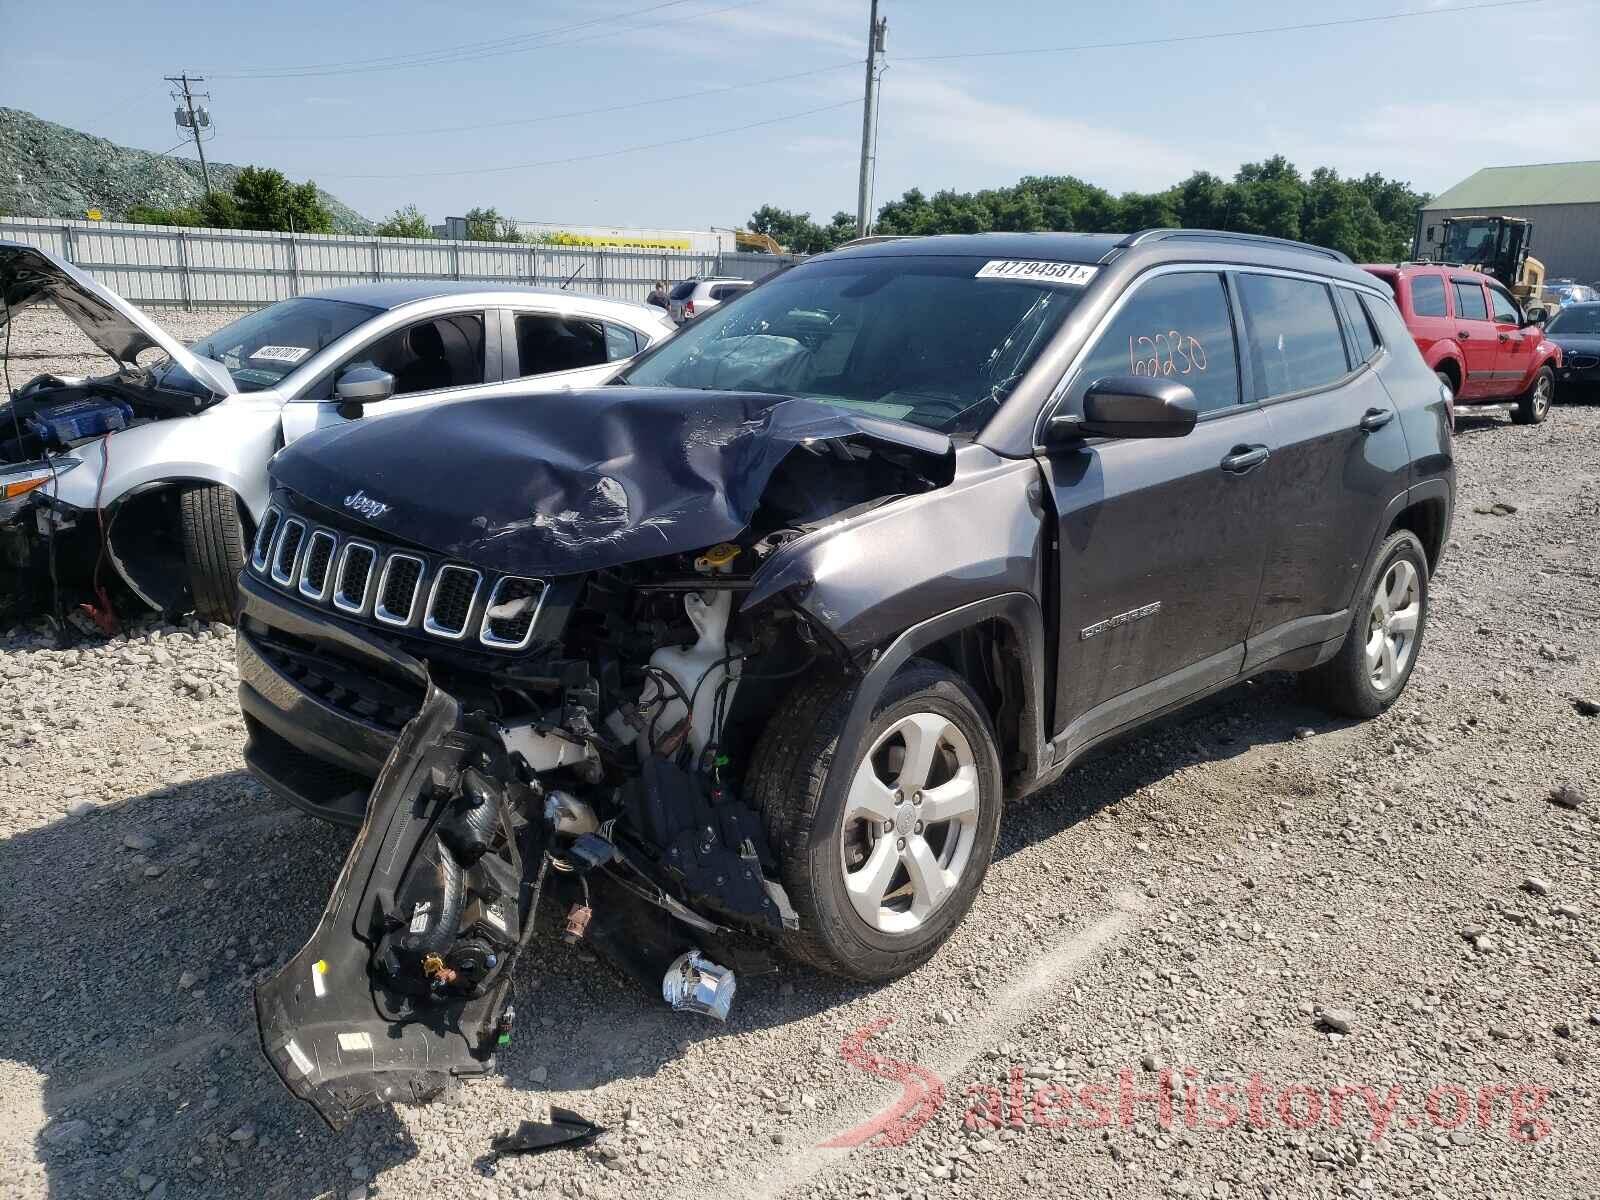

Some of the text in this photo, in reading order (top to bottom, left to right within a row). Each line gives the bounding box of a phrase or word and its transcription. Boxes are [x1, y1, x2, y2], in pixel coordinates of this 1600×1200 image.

[994, 261, 1079, 279] 47794581
[1129, 330, 1207, 378] 62230
[343, 490, 388, 519] Jeep
